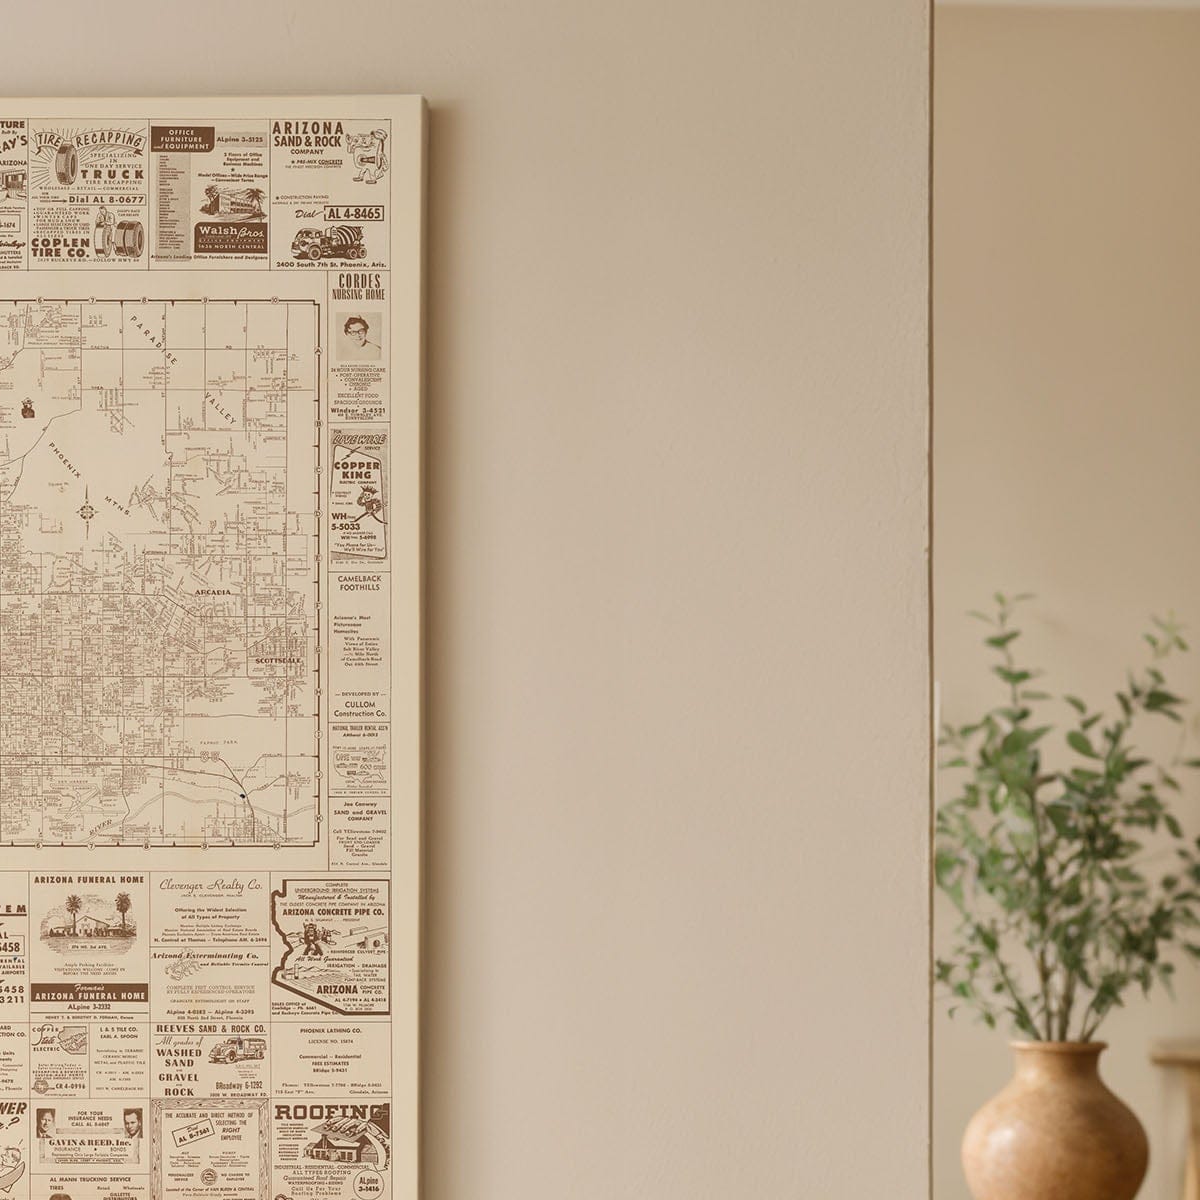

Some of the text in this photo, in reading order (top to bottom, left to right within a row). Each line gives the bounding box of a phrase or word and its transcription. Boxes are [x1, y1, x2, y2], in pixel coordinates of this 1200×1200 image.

[272, 121, 344, 135] ARIZONA
[38, 131, 142, 147] TIRE RECAPPING
[274, 136, 341, 147] SAND & ROCK
[81, 170, 144, 179] TRUCK
[328, 208, 381, 219] AL 4-8465
[199, 226, 237, 235] Walsh
[31, 238, 90, 248] COPLEN
[31, 248, 90, 257] TIRE CO.
[339, 273, 381, 289] CORDES
[332, 289, 385, 300] NURSING HOME
[130, 315, 178, 366] PARADISE
[204, 391, 237, 425] VALLEY
[48, 442, 82, 479] PHOENIX
[334, 461, 380, 470] COPPER
[342, 471, 372, 479] KING
[331, 523, 360, 531] 5-5033
[34, 876, 145, 884] ARIZONA FUNERAL HOME
[207, 879, 244, 893] Realty
[247, 879, 263, 890] Co.
[317, 908, 352, 916] CONCRETE
[354, 908, 370, 916] PIPE
[372, 908, 385, 916] CO.
[316, 985, 358, 995] ARIZONA
[35, 993, 74, 1001] ARIZONA
[121, 992, 145, 1000] HOME
[156, 1024, 266, 1033] REEVES SAND & ROCK CO.
[156, 1049, 202, 1057] WASHED
[164, 1059, 194, 1067] SAND
[158, 1073, 199, 1082] GRAVEL
[164, 1088, 194, 1096] ROCK
[274, 1104, 384, 1120] ROOFING
